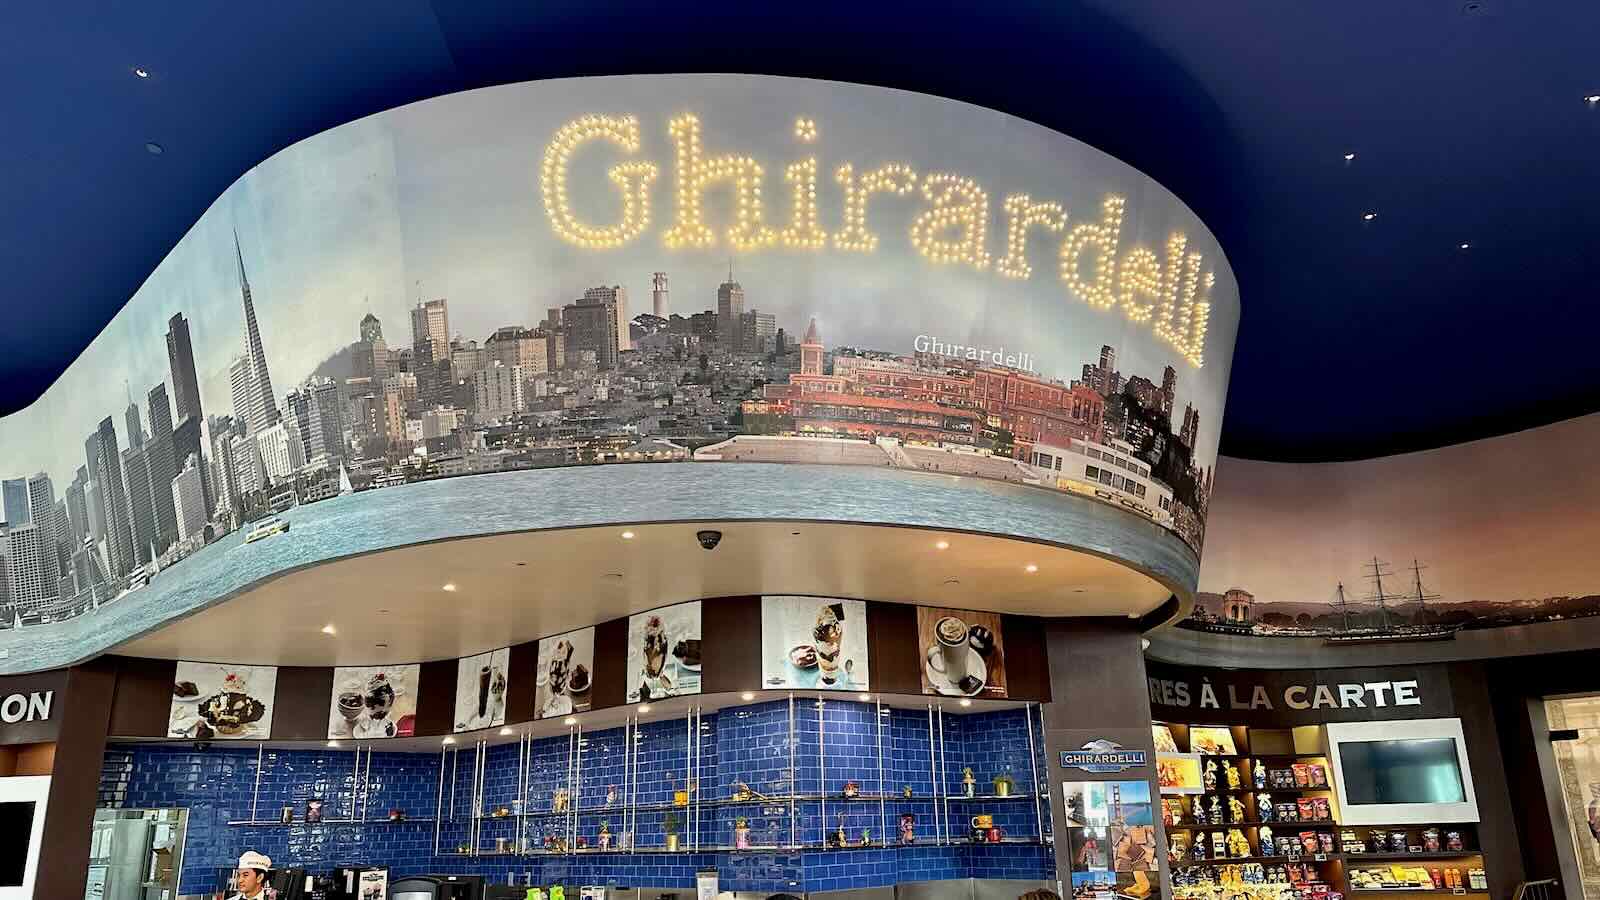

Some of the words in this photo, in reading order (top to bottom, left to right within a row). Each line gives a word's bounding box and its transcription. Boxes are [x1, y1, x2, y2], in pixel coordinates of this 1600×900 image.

[540, 113, 1214, 368] Ghirardelli
[914, 334, 1033, 371] Ghirardelli
[1200, 677, 1220, 709] À
[1228, 684, 1273, 710] LA
[1284, 680, 1421, 710] CARTE
[1064, 754, 1144, 764] GHIRARDELLI
